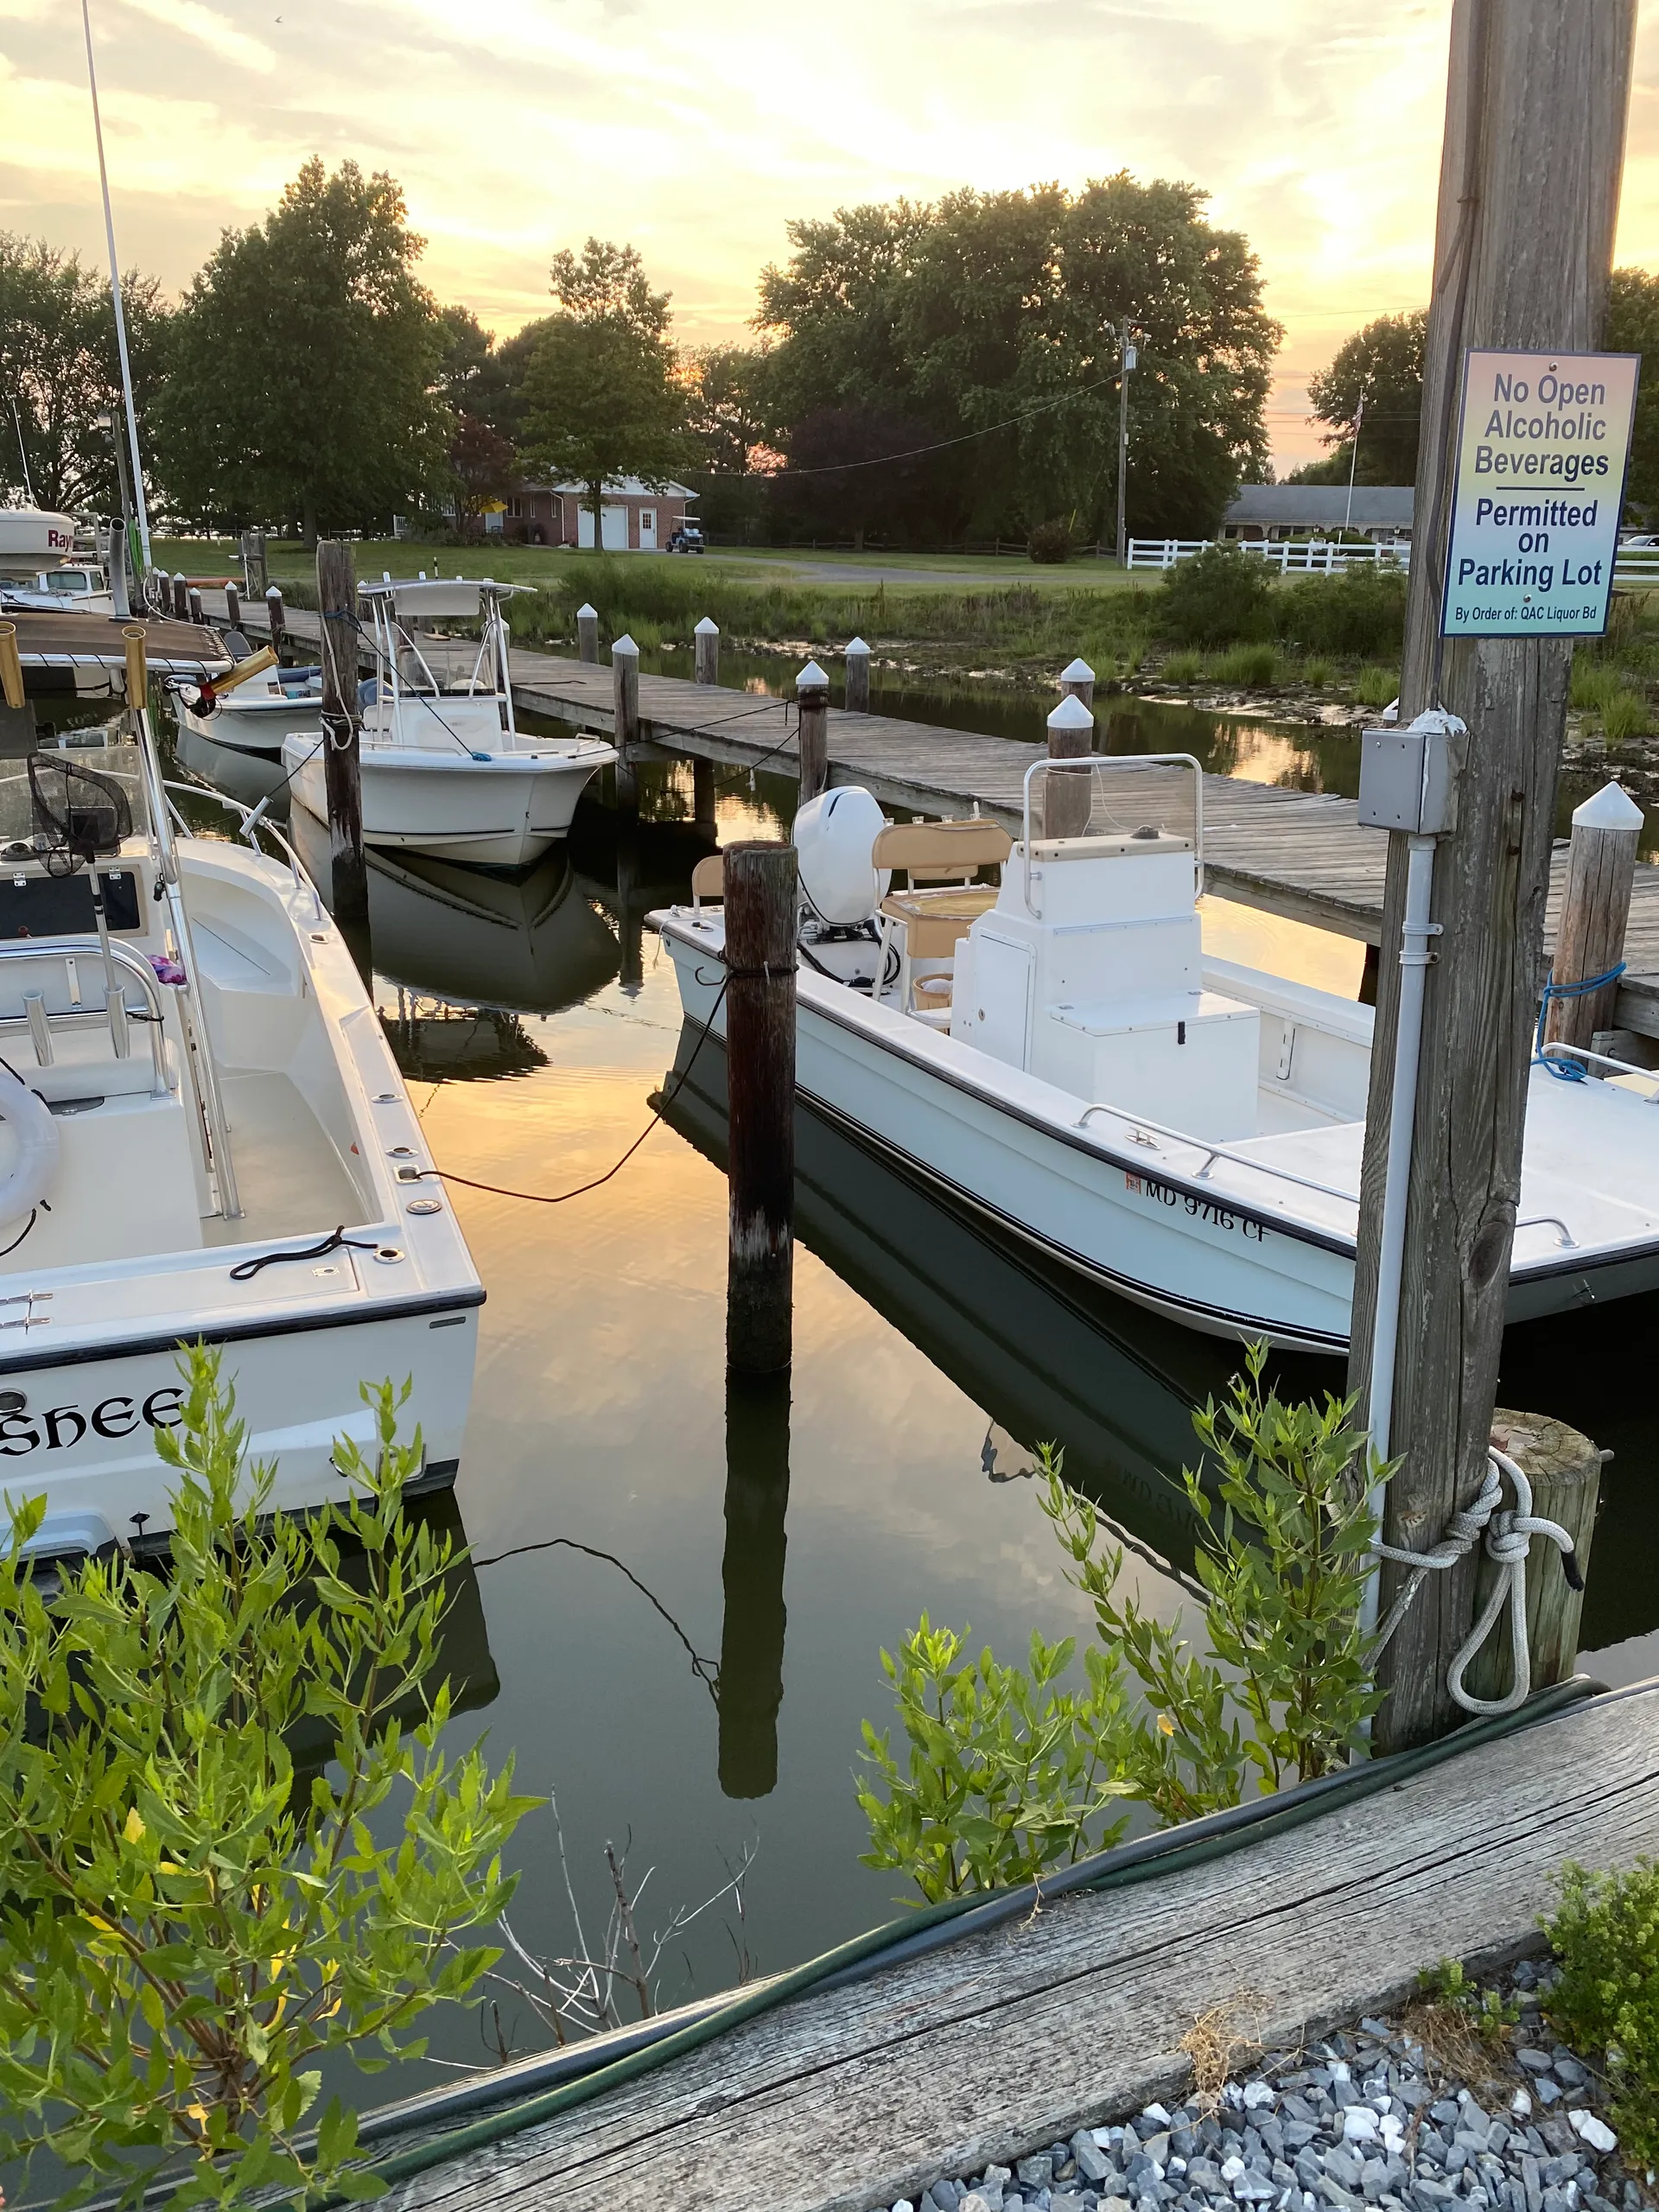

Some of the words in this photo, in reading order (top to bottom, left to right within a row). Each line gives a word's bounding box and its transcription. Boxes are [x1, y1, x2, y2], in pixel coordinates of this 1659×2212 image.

[1493, 373, 1529, 403] No
[1538, 375, 1605, 410] Open
[1484, 410, 1606, 441] Alcoholic
[1475, 446, 1609, 482] Beverages
[1476, 498, 1599, 527] Permitted
[1518, 532, 1549, 553] on
[1458, 558, 1554, 593] Parking
[1561, 560, 1602, 586] Lot
[1455, 607, 1469, 623] By
[1471, 607, 1502, 620] Order
[1503, 607, 1517, 620] of:
[1520, 606, 1544, 620] QAC
[1547, 606, 1580, 622] Liquor
[1582, 606, 1597, 620] Bd
[1146, 1181, 1176, 1206] MD
[1185, 1196, 1234, 1230] 9716
